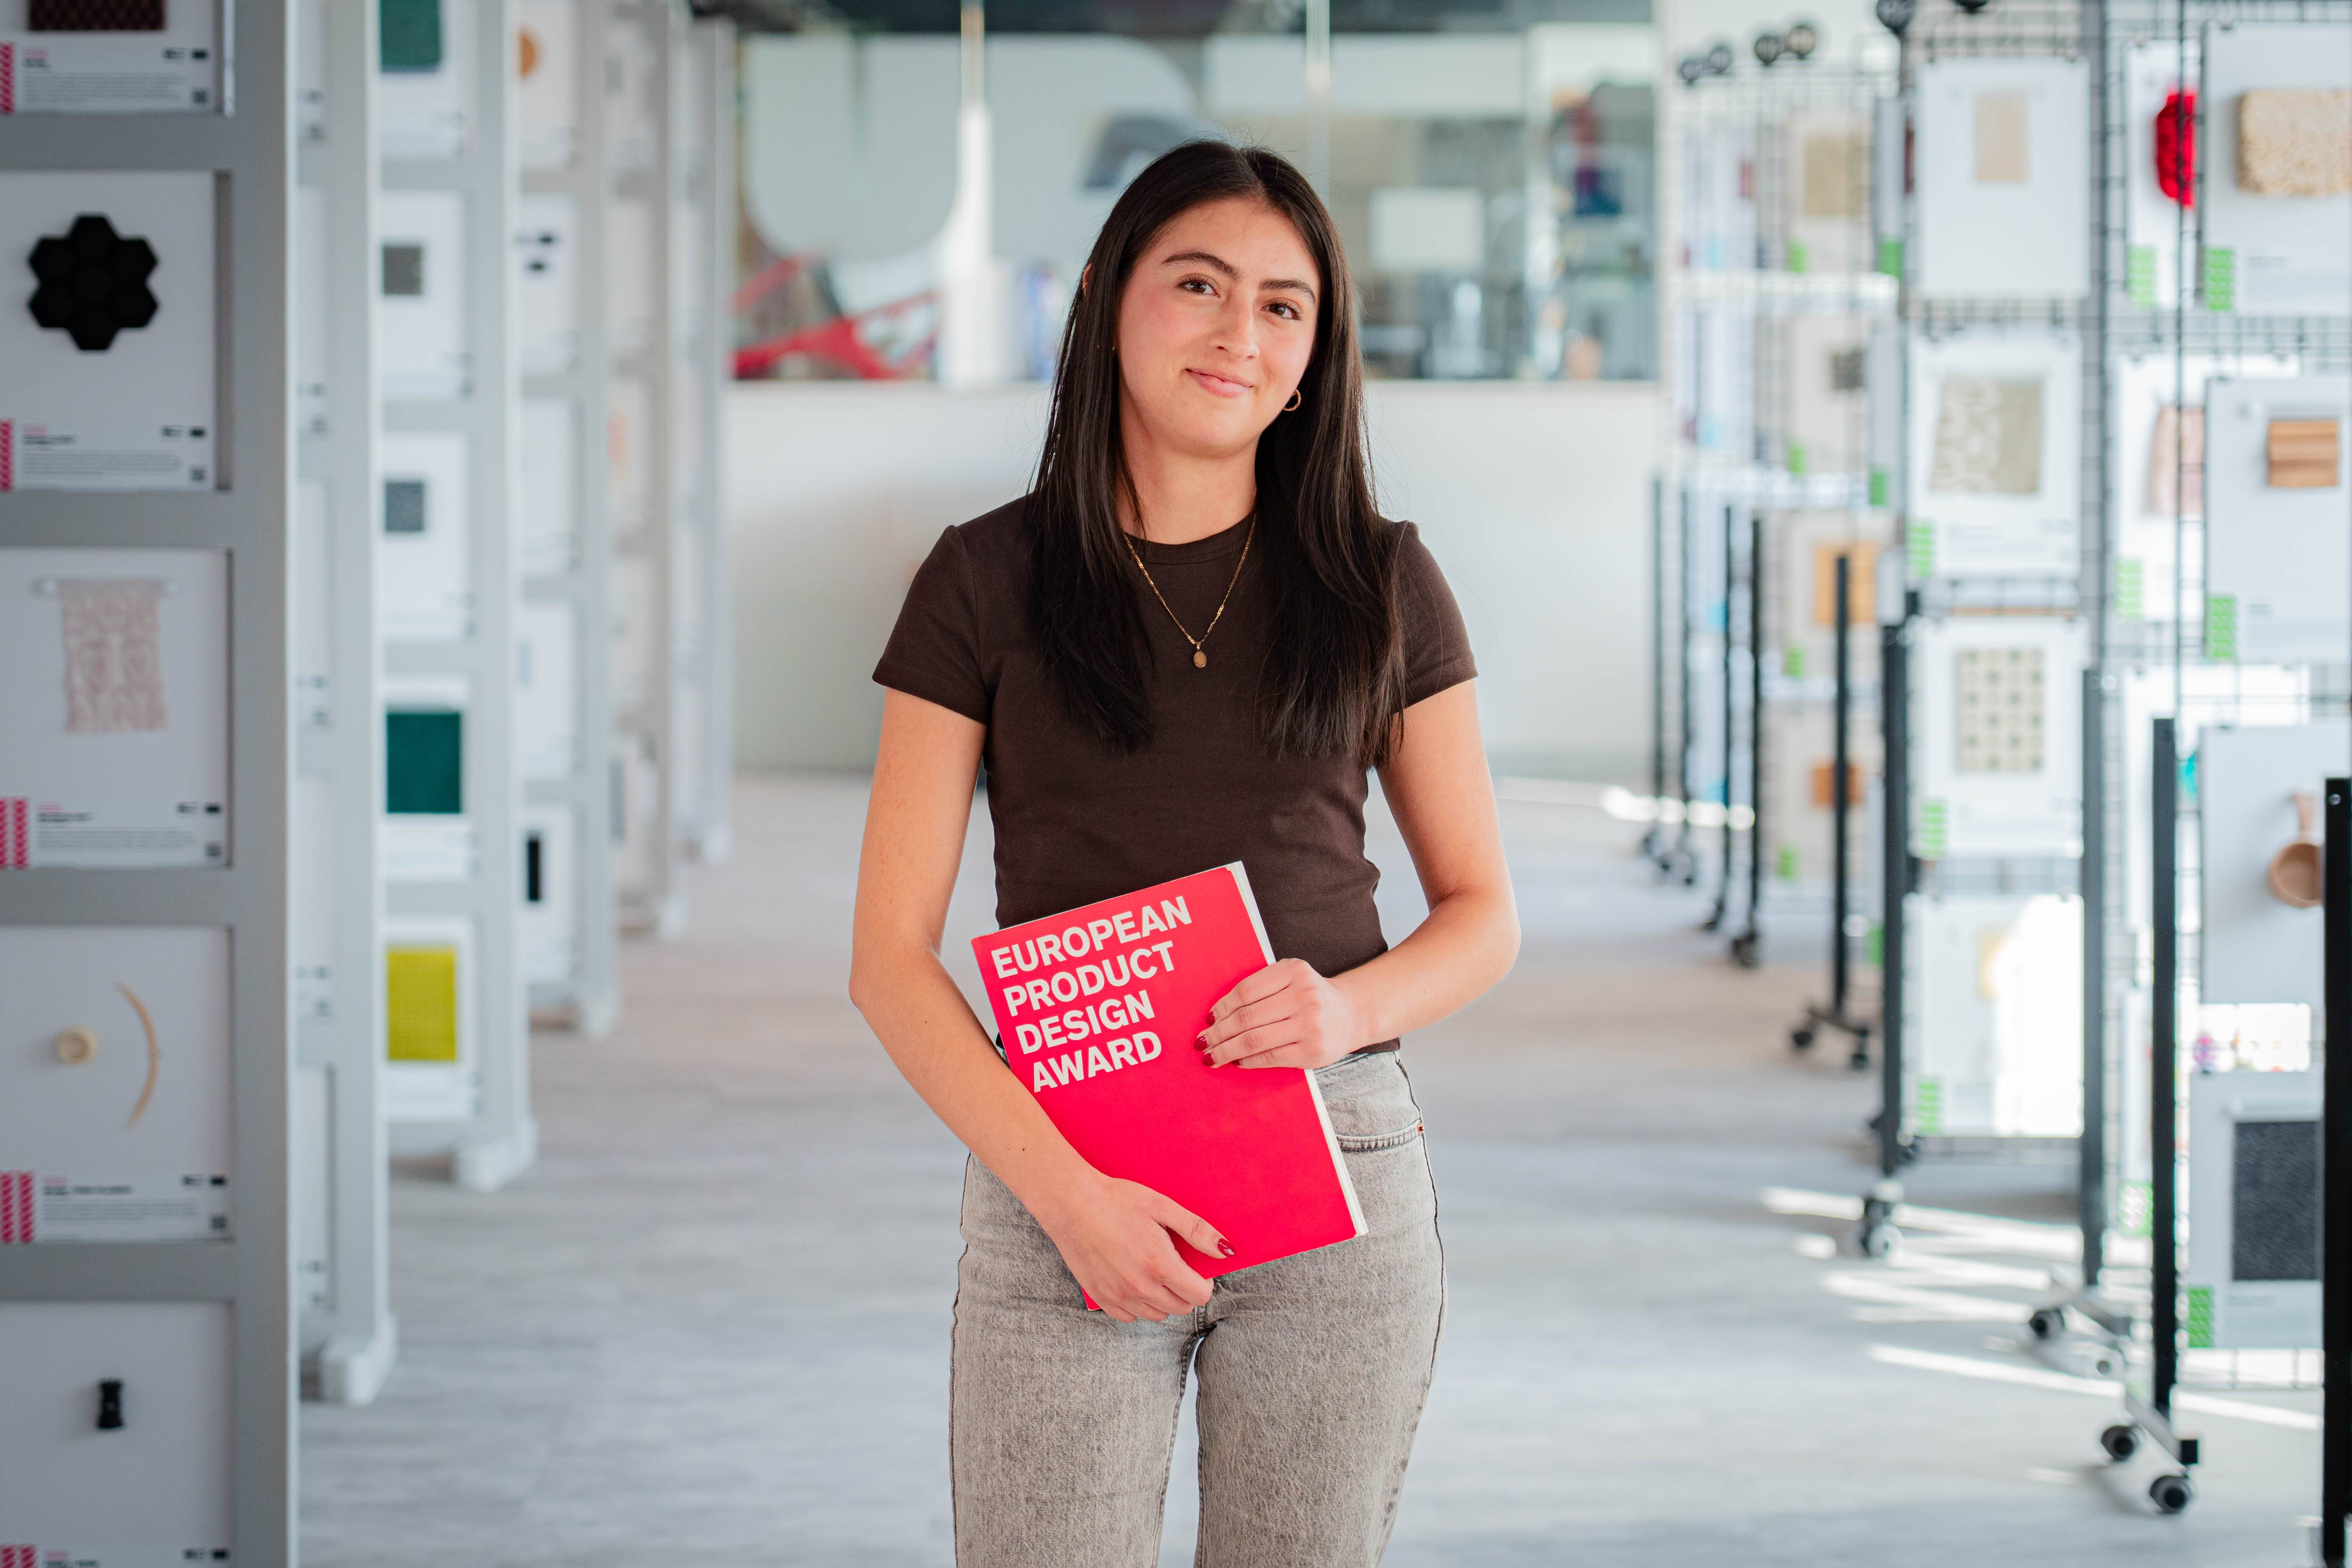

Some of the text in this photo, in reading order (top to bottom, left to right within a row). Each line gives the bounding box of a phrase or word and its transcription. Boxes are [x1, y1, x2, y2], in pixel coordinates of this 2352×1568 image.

[991, 896, 1192, 979] EUROPEAN
[1003, 940, 1175, 1017] PRODUCT
[1015, 990, 1155, 1054] DESIGN
[1034, 1031, 1162, 1093] AWARD
